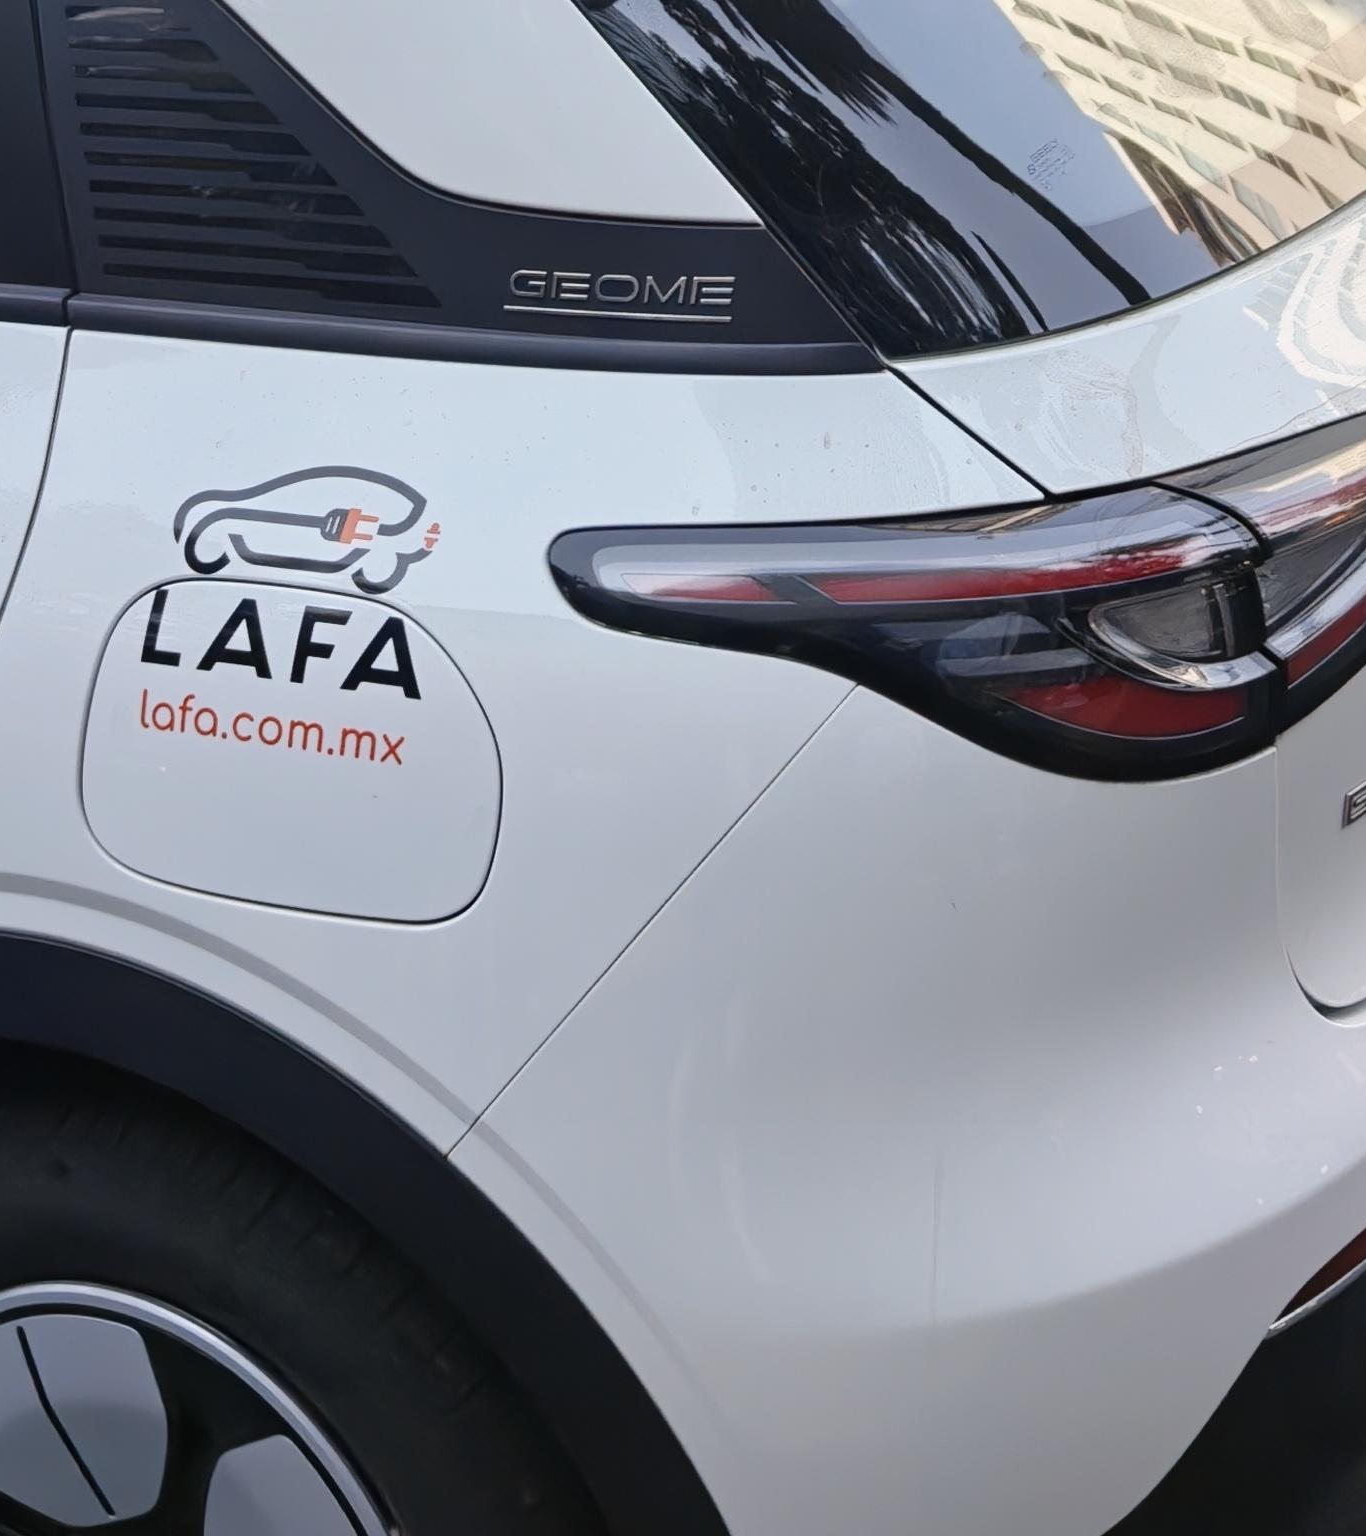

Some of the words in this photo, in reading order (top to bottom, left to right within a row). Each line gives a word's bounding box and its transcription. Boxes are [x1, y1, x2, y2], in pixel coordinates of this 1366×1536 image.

[509, 269, 735, 306] GEOME
[140, 589, 422, 700] LAFA
[140, 688, 405, 765] lafa.com.mx
